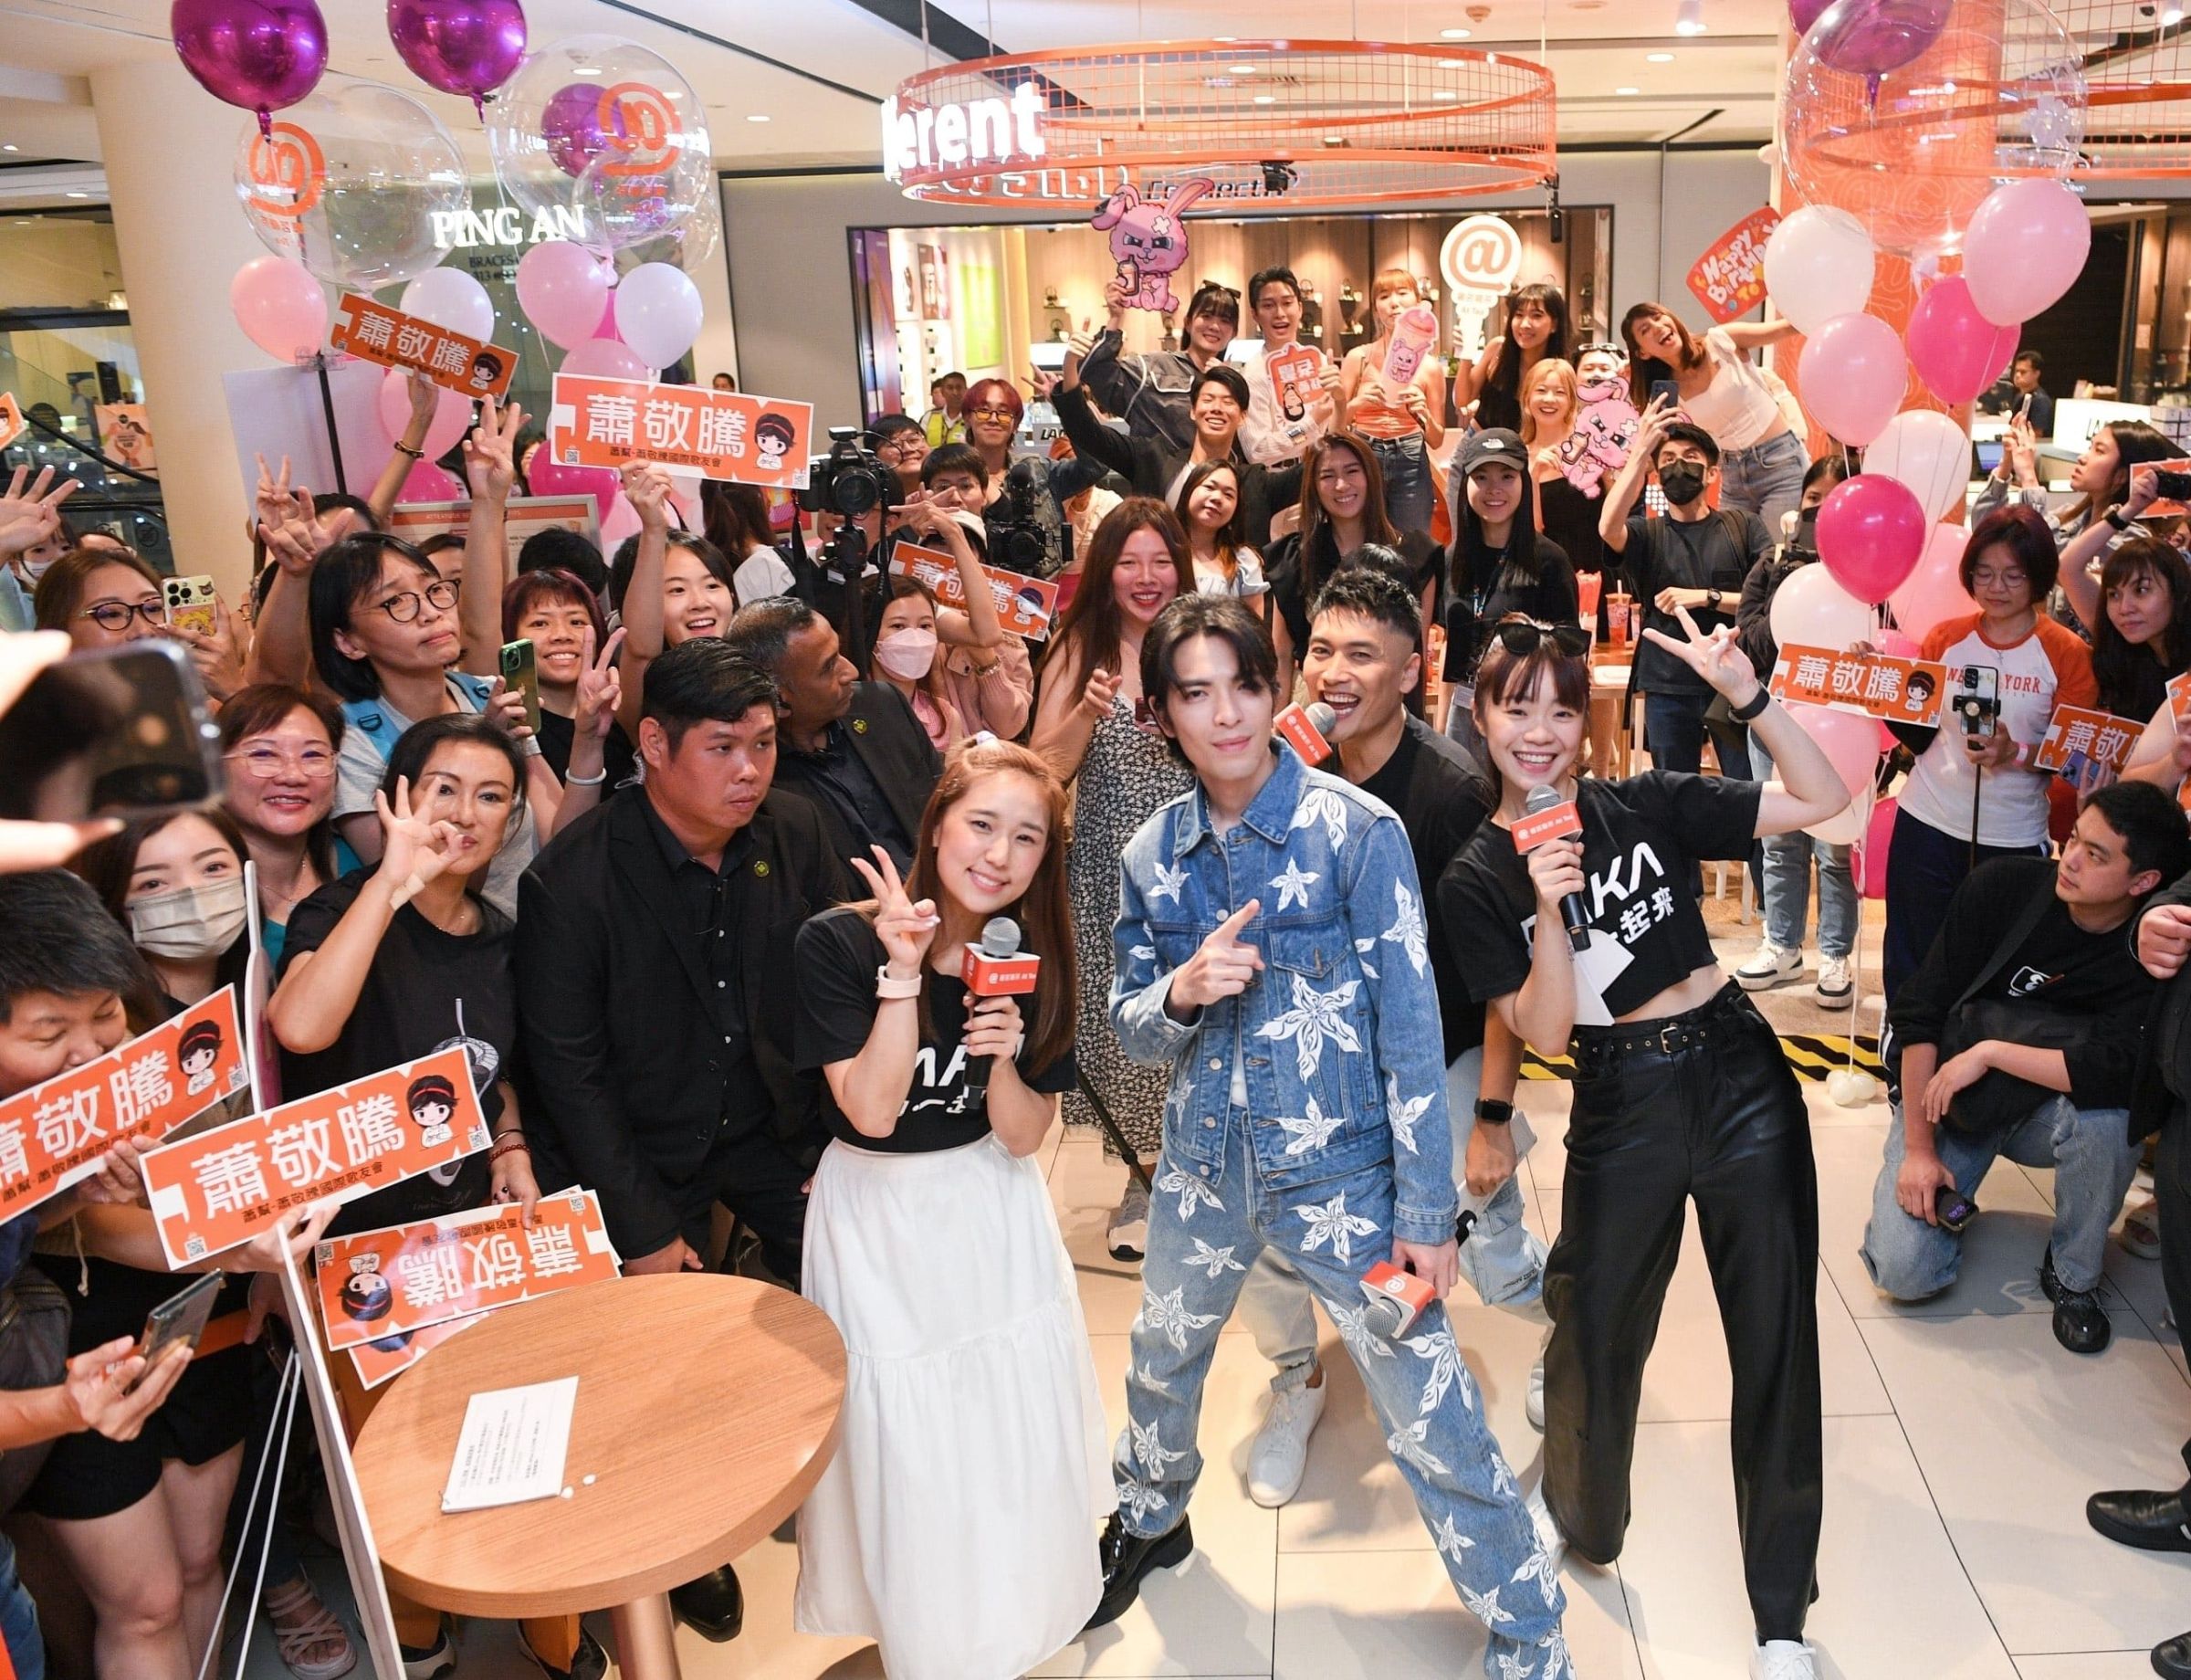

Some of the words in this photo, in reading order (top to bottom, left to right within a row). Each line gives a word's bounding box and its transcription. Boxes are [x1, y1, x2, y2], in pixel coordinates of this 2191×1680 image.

[430, 206, 523, 247] PING
[529, 204, 587, 243] AN
[354, 310, 470, 377] 蕭敬騰
[586, 393, 748, 457] 蕭敬騰
[1792, 654, 1903, 703] 蕭敬騰
[2004, 674, 2040, 694] YORK
[191, 1093, 406, 1220] 蕭敬騰
[397, 1223, 583, 1308] 蕭敬騰
